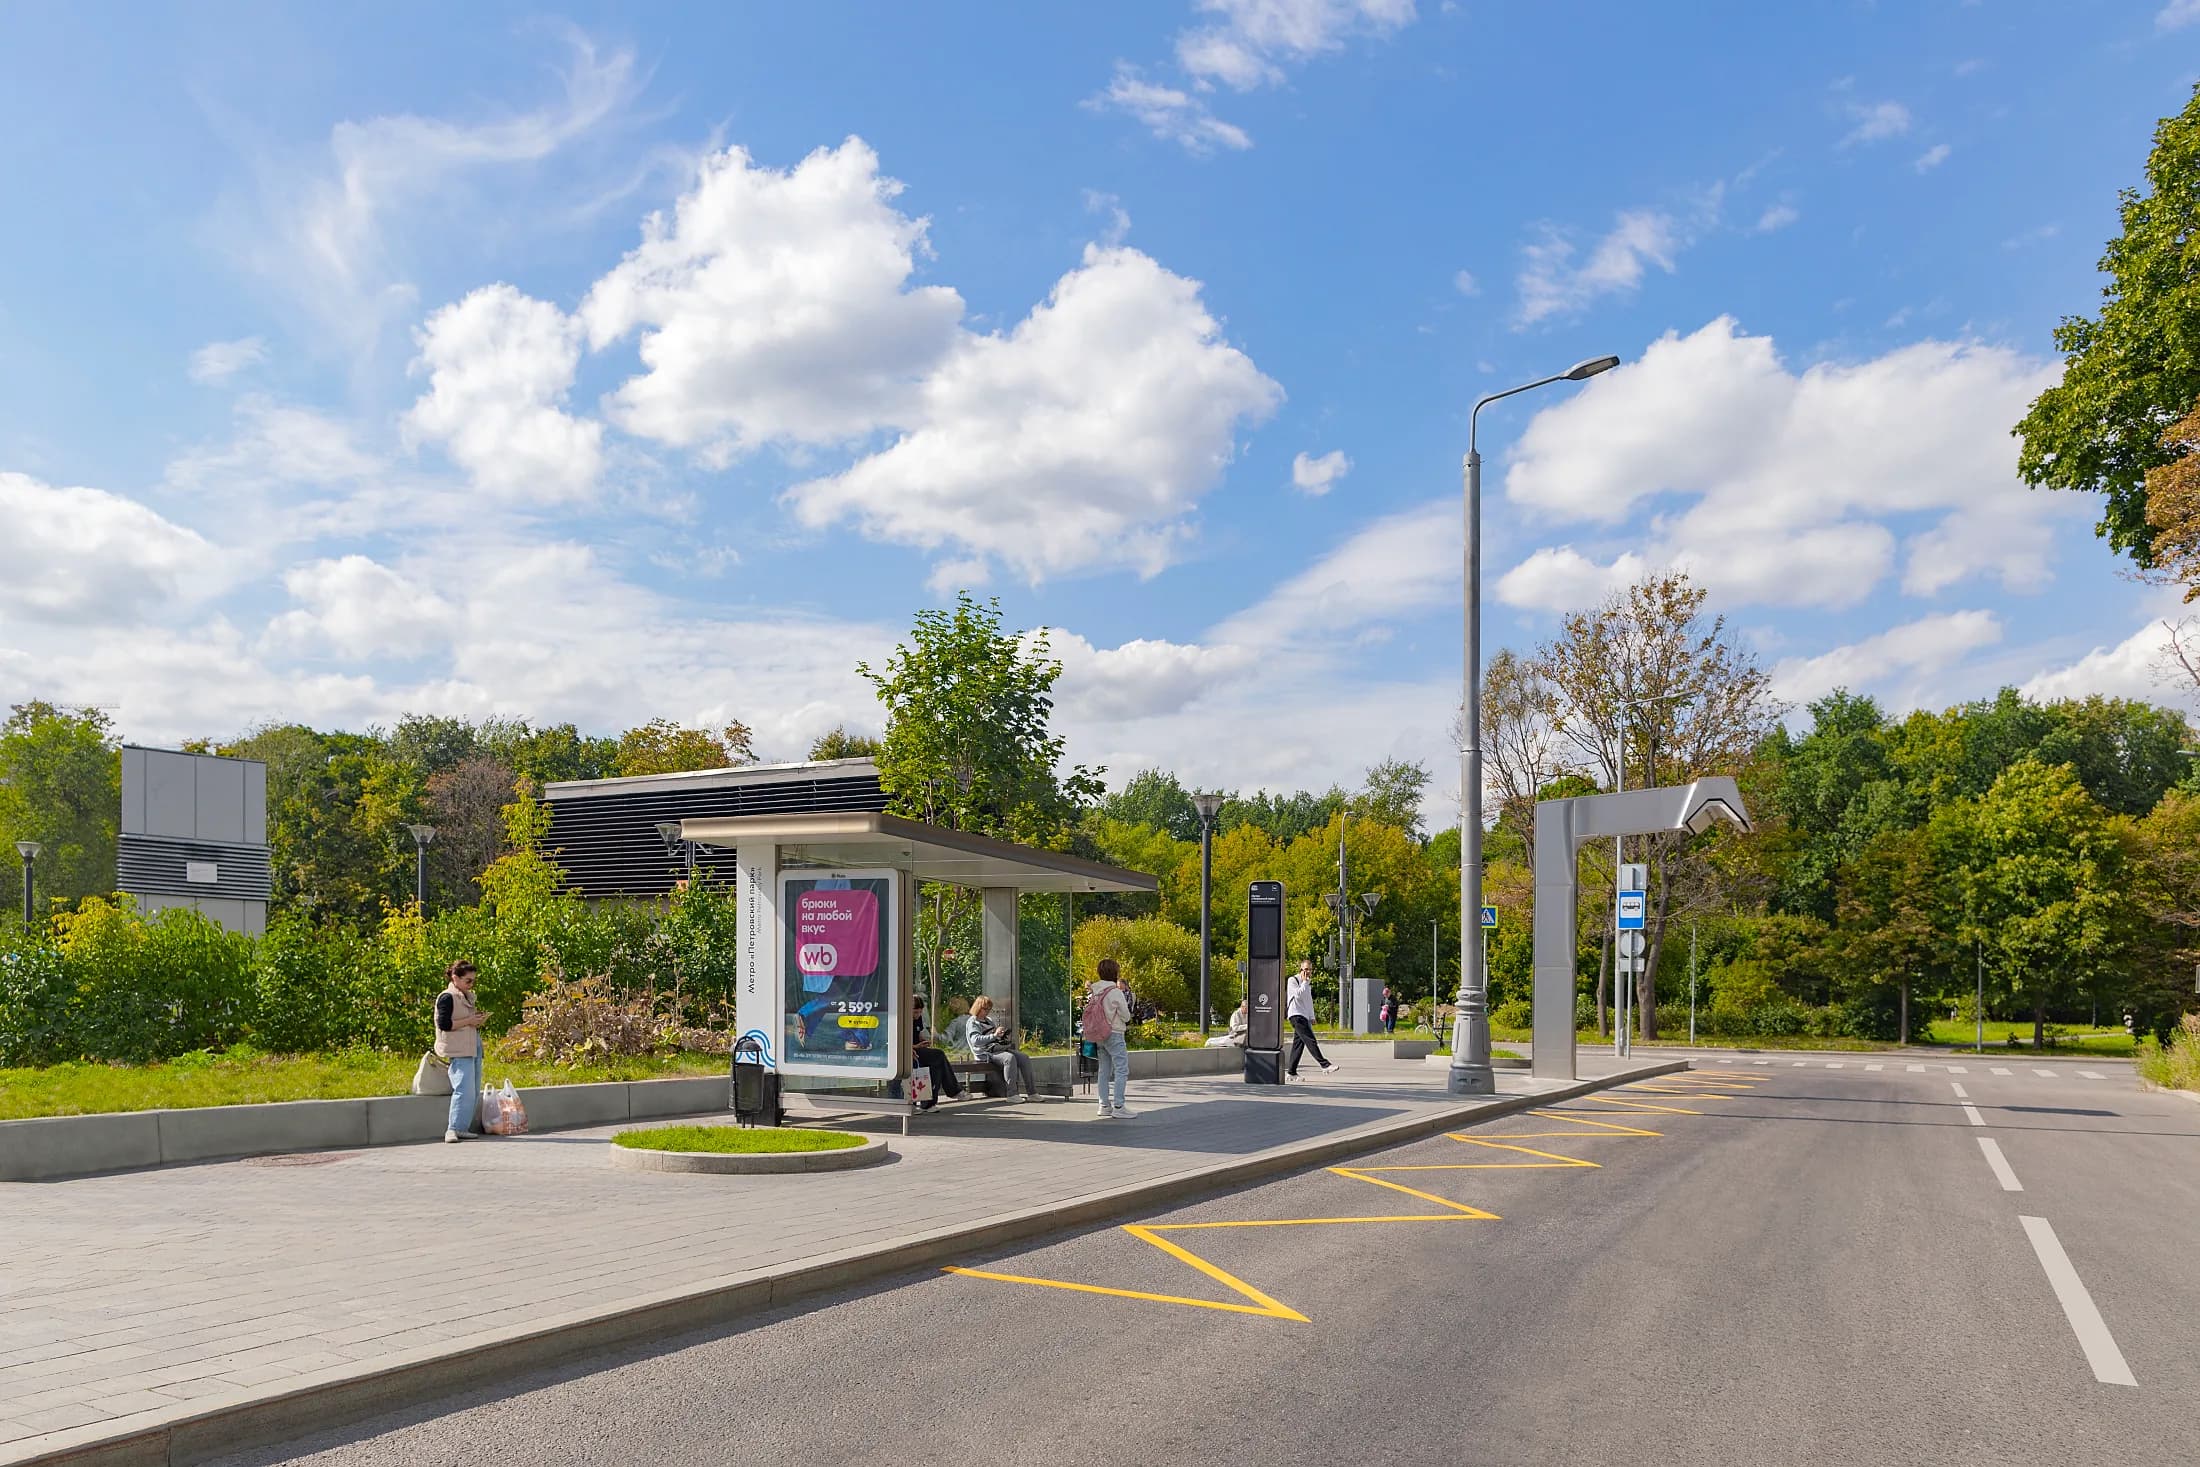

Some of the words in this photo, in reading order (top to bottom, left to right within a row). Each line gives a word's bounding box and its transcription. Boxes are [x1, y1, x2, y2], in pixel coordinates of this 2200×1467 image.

[748, 866, 757, 895] парк»
[801, 898, 837, 911] брюки
[801, 912, 815, 921] на
[816, 909, 853, 921] любой
[748, 897, 757, 960] «Петровский
[801, 924, 826, 935] вкус
[803, 945, 833, 966] wb
[748, 961, 757, 994] Метро
